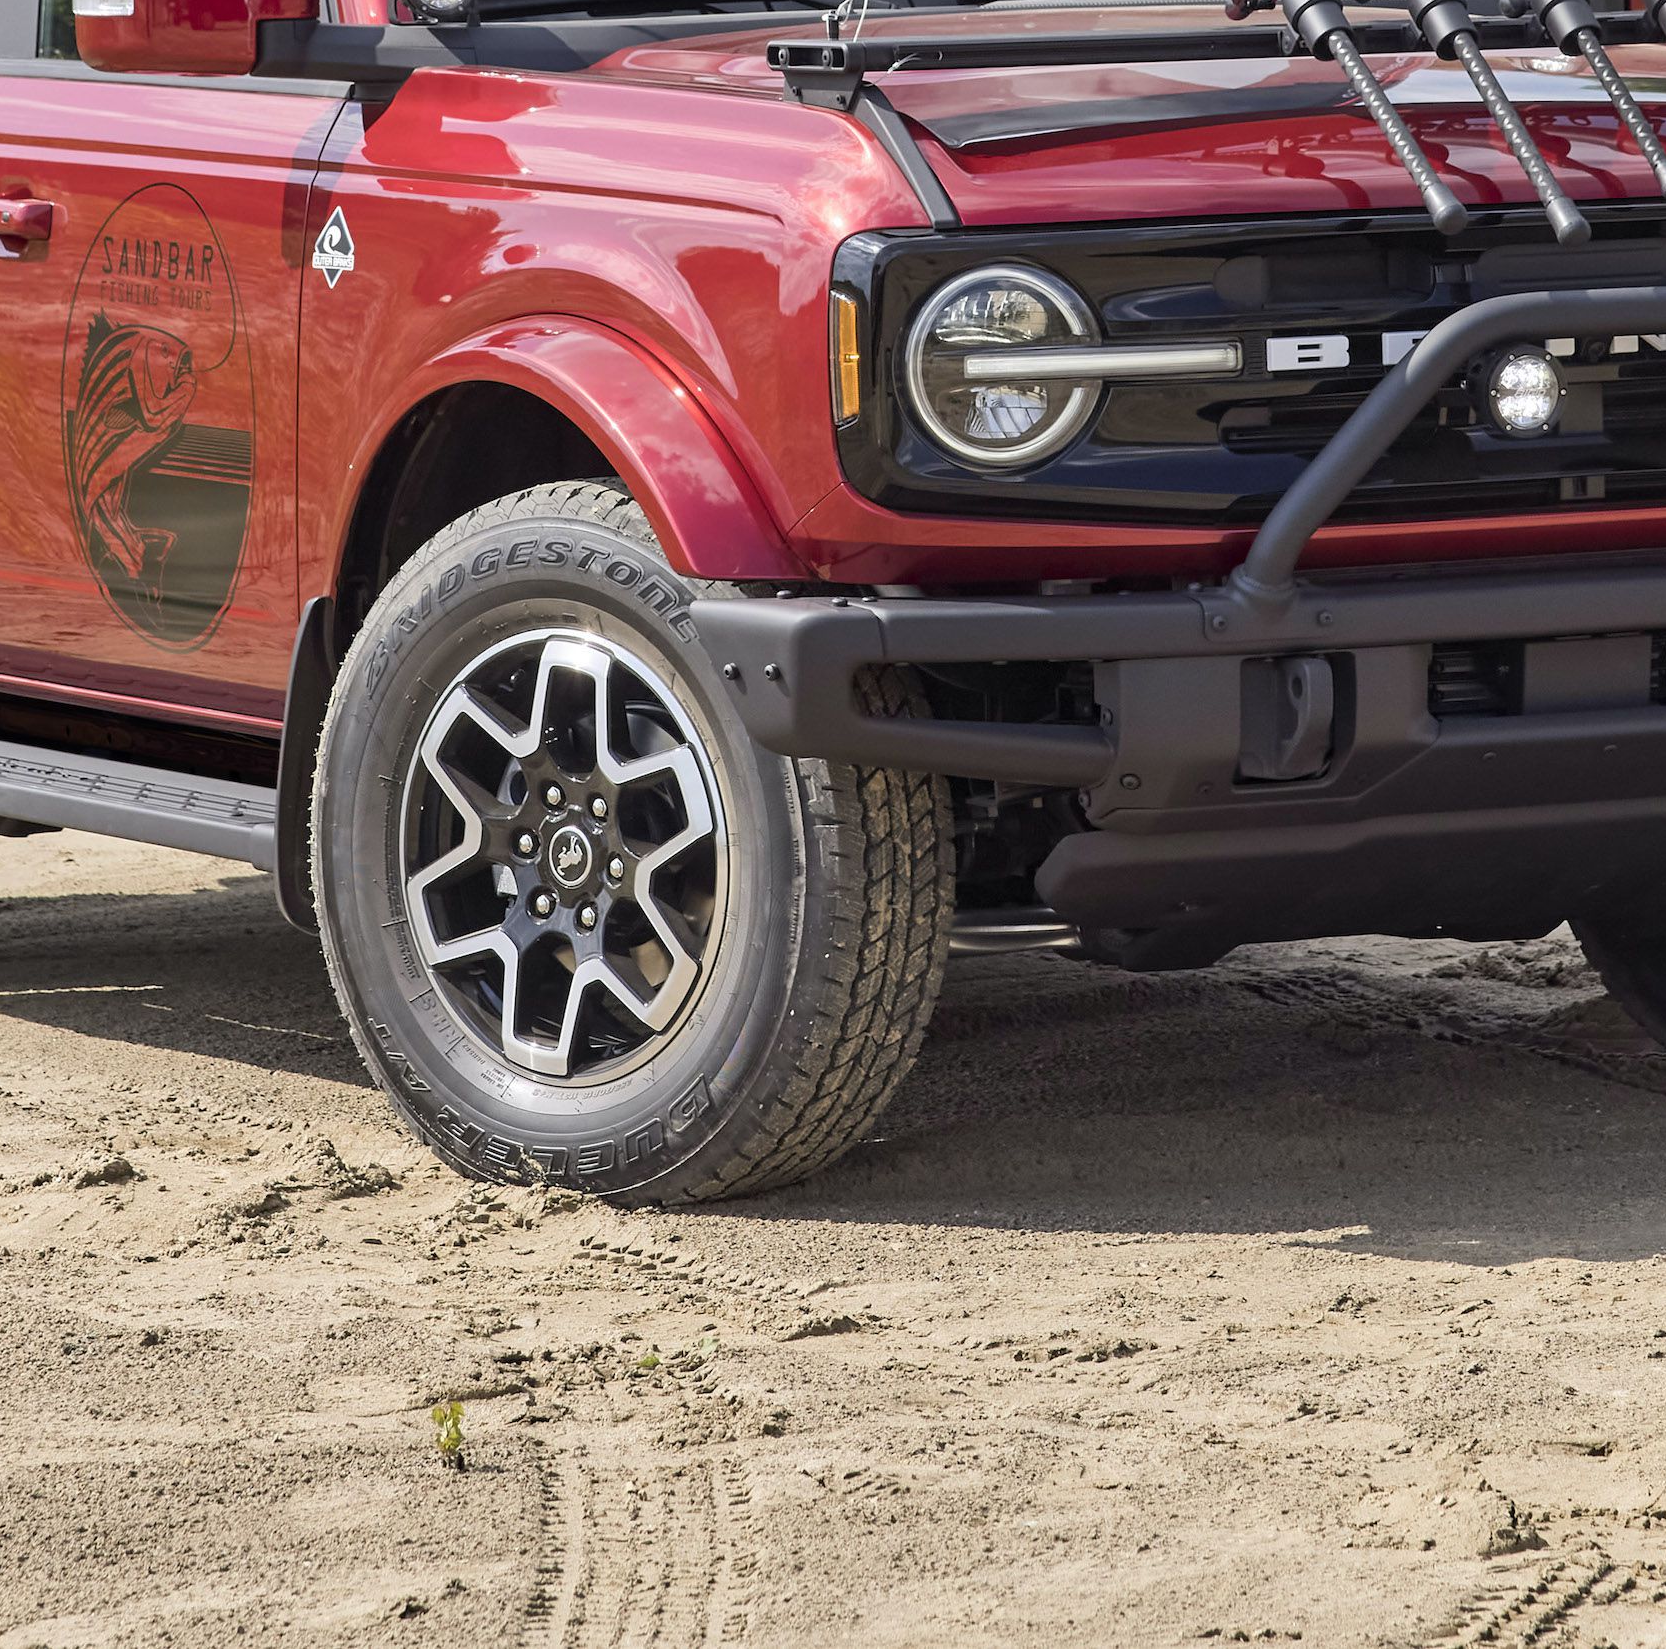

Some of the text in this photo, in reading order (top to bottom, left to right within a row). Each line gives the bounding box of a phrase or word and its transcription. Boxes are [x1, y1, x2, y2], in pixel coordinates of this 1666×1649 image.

[100, 280, 213, 311] FISHING TOURS
[102, 235, 214, 285] SANDBAR
[364, 536, 702, 701] BRIDGESTONE
[436, 1072, 715, 1177] DUELER
